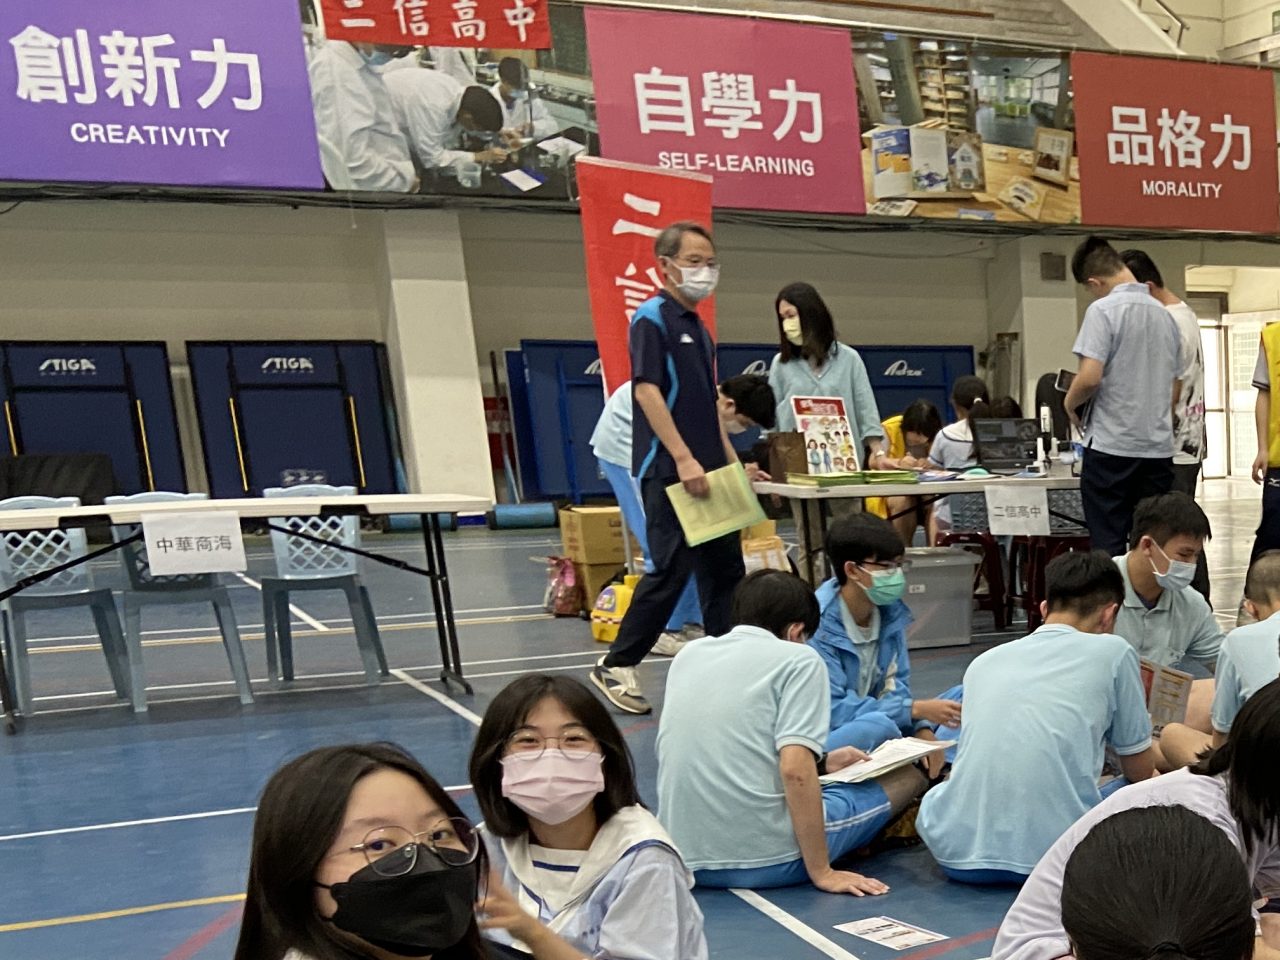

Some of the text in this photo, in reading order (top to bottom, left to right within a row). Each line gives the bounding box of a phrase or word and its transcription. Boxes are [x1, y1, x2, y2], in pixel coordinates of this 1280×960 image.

[338, 0, 536, 42] 二信高中
[9, 25, 264, 111] 創新力
[634, 67, 824, 144] 自學力
[70, 123, 230, 148] CREATIVITY
[1107, 106, 1252, 171] 品格力
[658, 151, 815, 178] SELF-LEARNING
[1142, 179, 1222, 199] MORALITY
[156, 535, 232, 554] 中華商海
